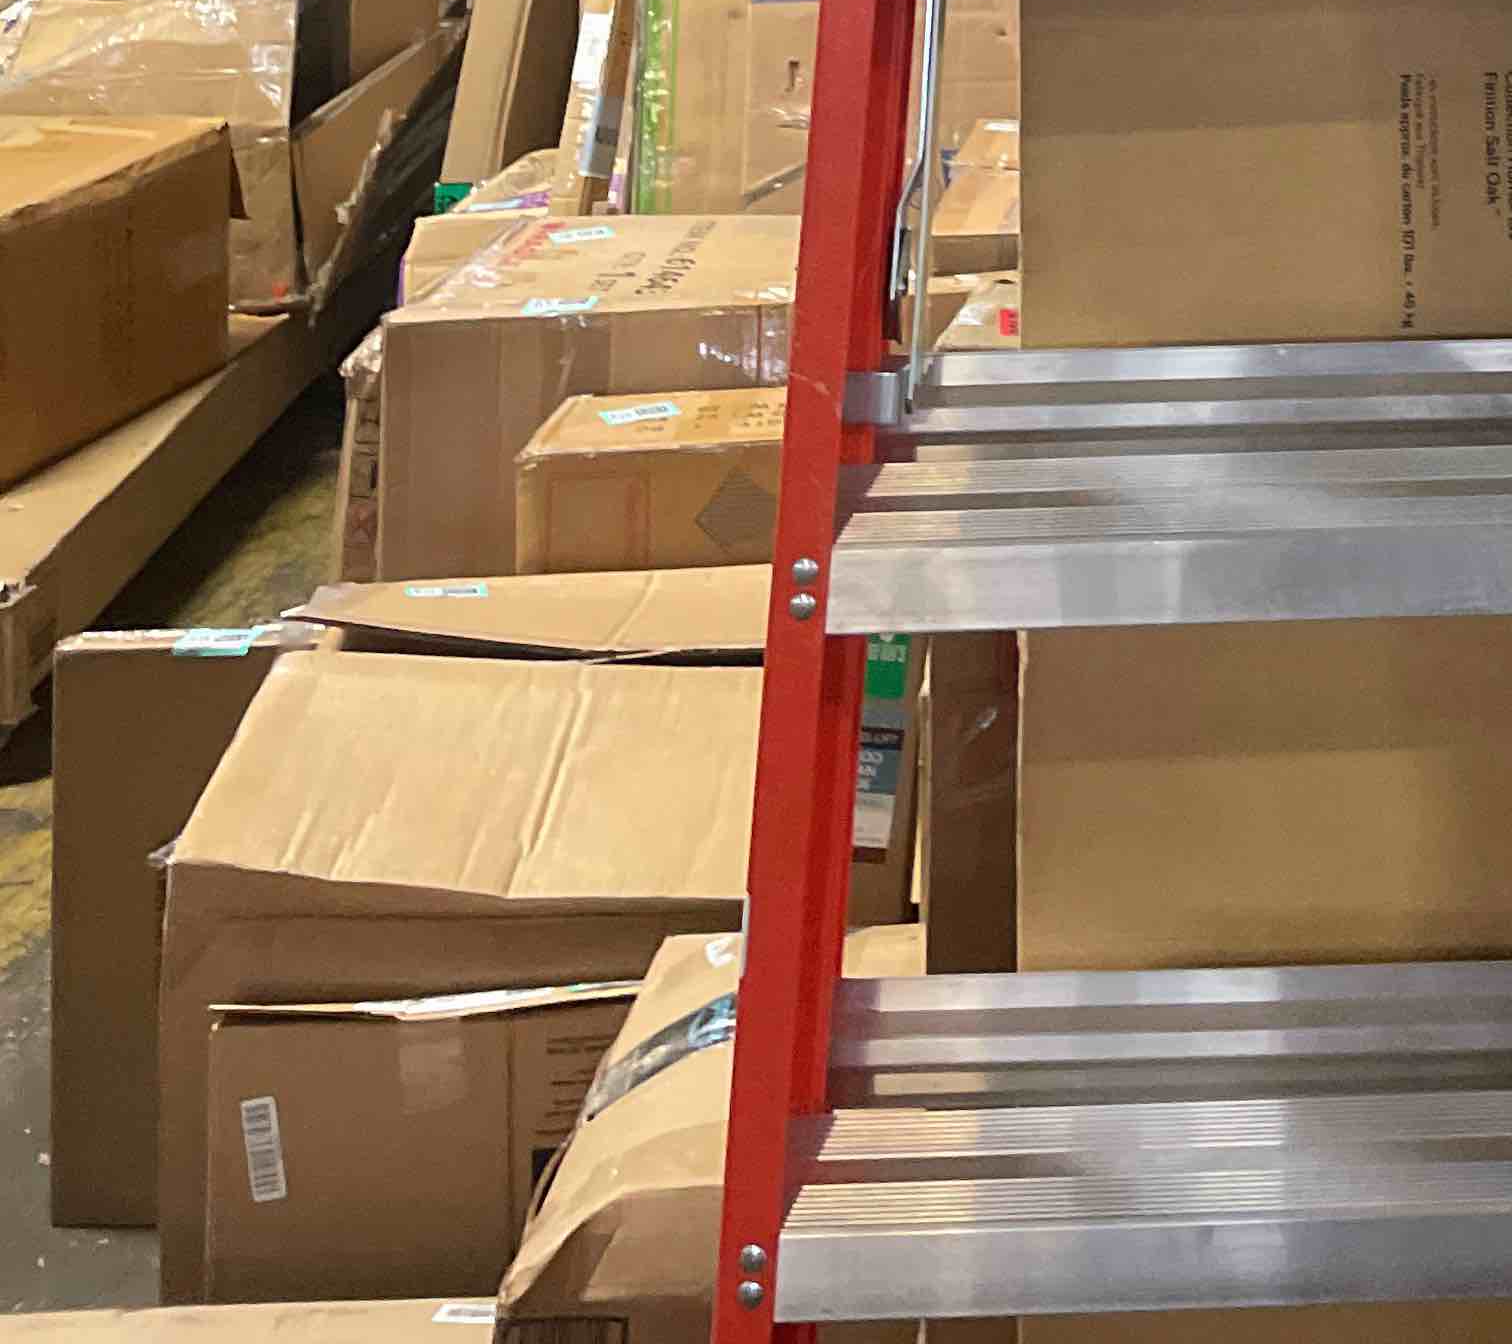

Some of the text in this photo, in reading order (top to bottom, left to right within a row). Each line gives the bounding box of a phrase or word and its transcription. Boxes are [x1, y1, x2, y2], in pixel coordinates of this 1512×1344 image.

[1405, 183, 1413, 225] carton
[1488, 172, 1499, 205] Oak
[1402, 313, 1415, 329] kg
